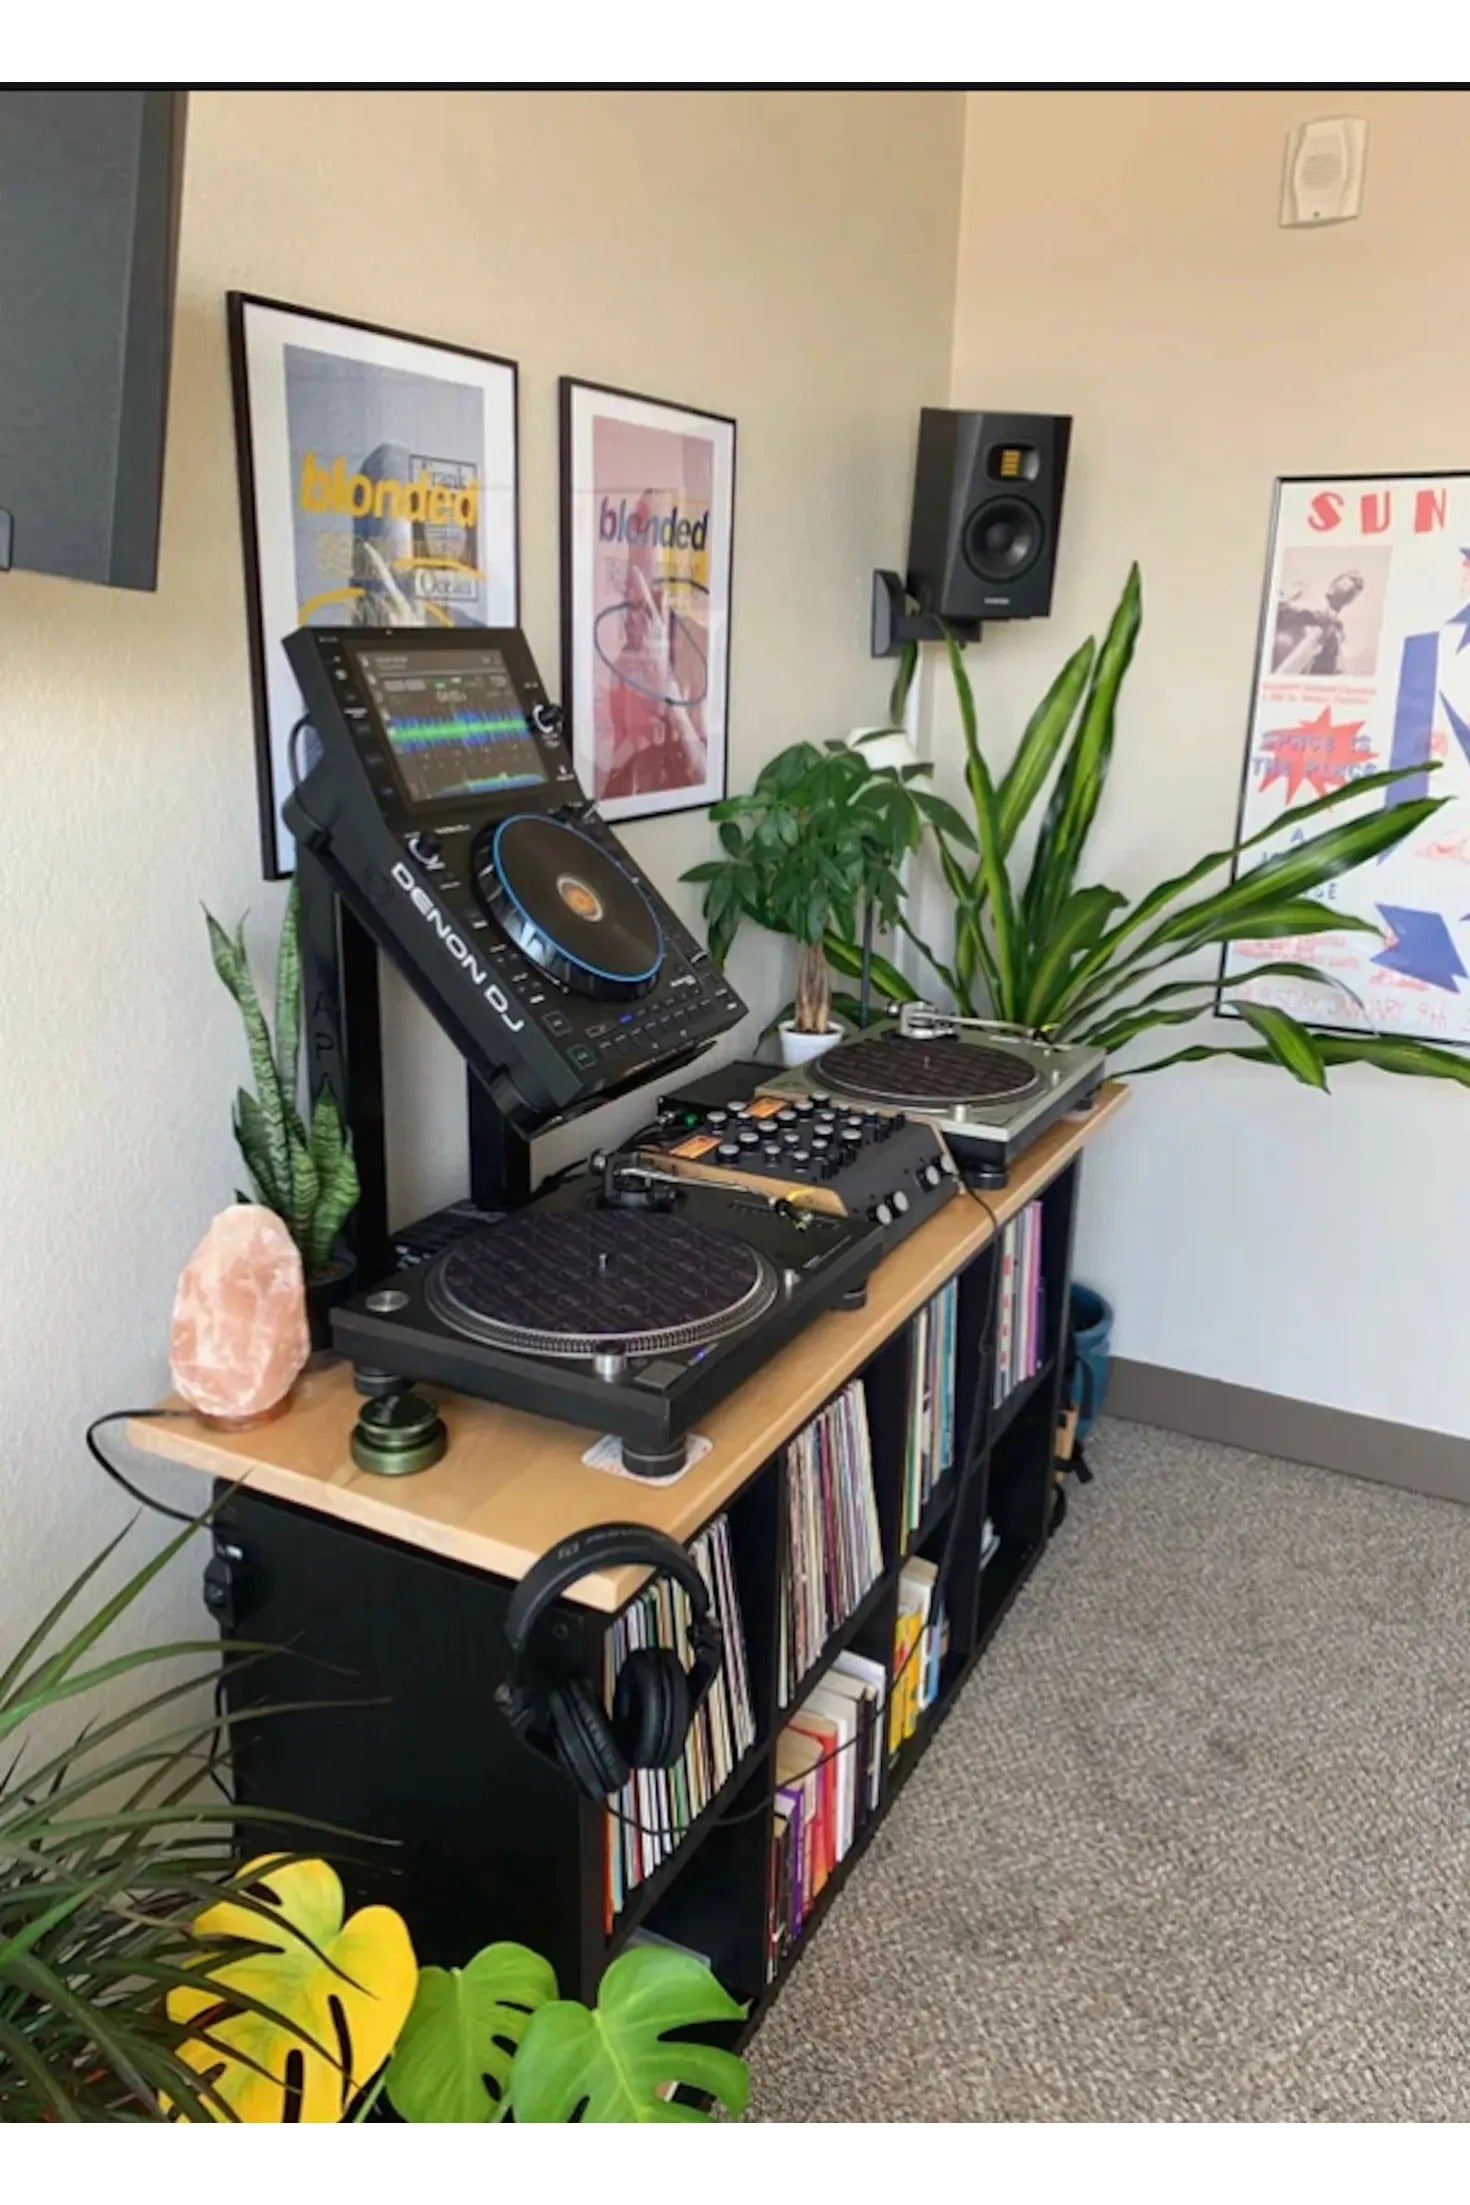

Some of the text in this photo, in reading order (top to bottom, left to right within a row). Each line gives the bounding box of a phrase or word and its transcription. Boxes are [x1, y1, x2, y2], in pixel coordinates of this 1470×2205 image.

[302, 452, 480, 527] blonded
[1306, 488, 1447, 535] SUN
[599, 496, 709, 551] blonded
[391, 861, 487, 985] DENON
[484, 984, 525, 1032] DJ
